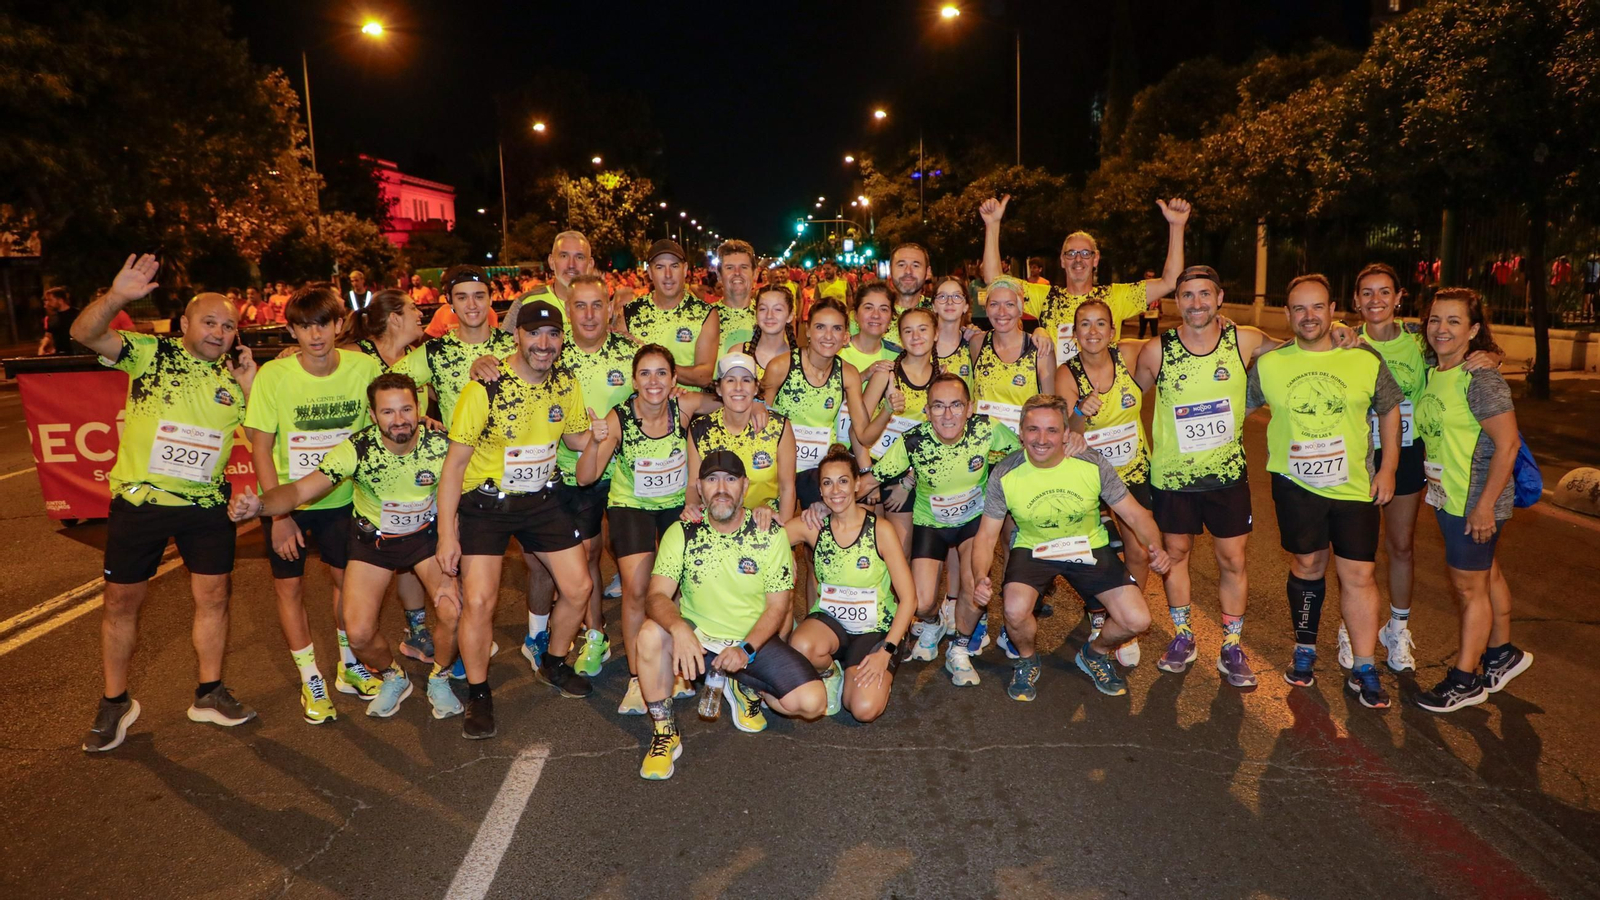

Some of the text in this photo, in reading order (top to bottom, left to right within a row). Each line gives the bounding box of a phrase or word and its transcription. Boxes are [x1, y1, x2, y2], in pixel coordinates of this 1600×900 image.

[1286, 371, 1318, 388] CAMINANTES
[1185, 420, 1226, 439] 3316
[162, 445, 211, 467] 3297
[512, 463, 550, 480] 3314
[1293, 457, 1343, 475] 12277
[643, 469, 682, 487] 3317
[1026, 488, 1055, 509] CAMINANTES
[940, 499, 976, 517] 3293
[827, 605, 867, 621] 3298
[1298, 591, 1316, 629] Kalenji
